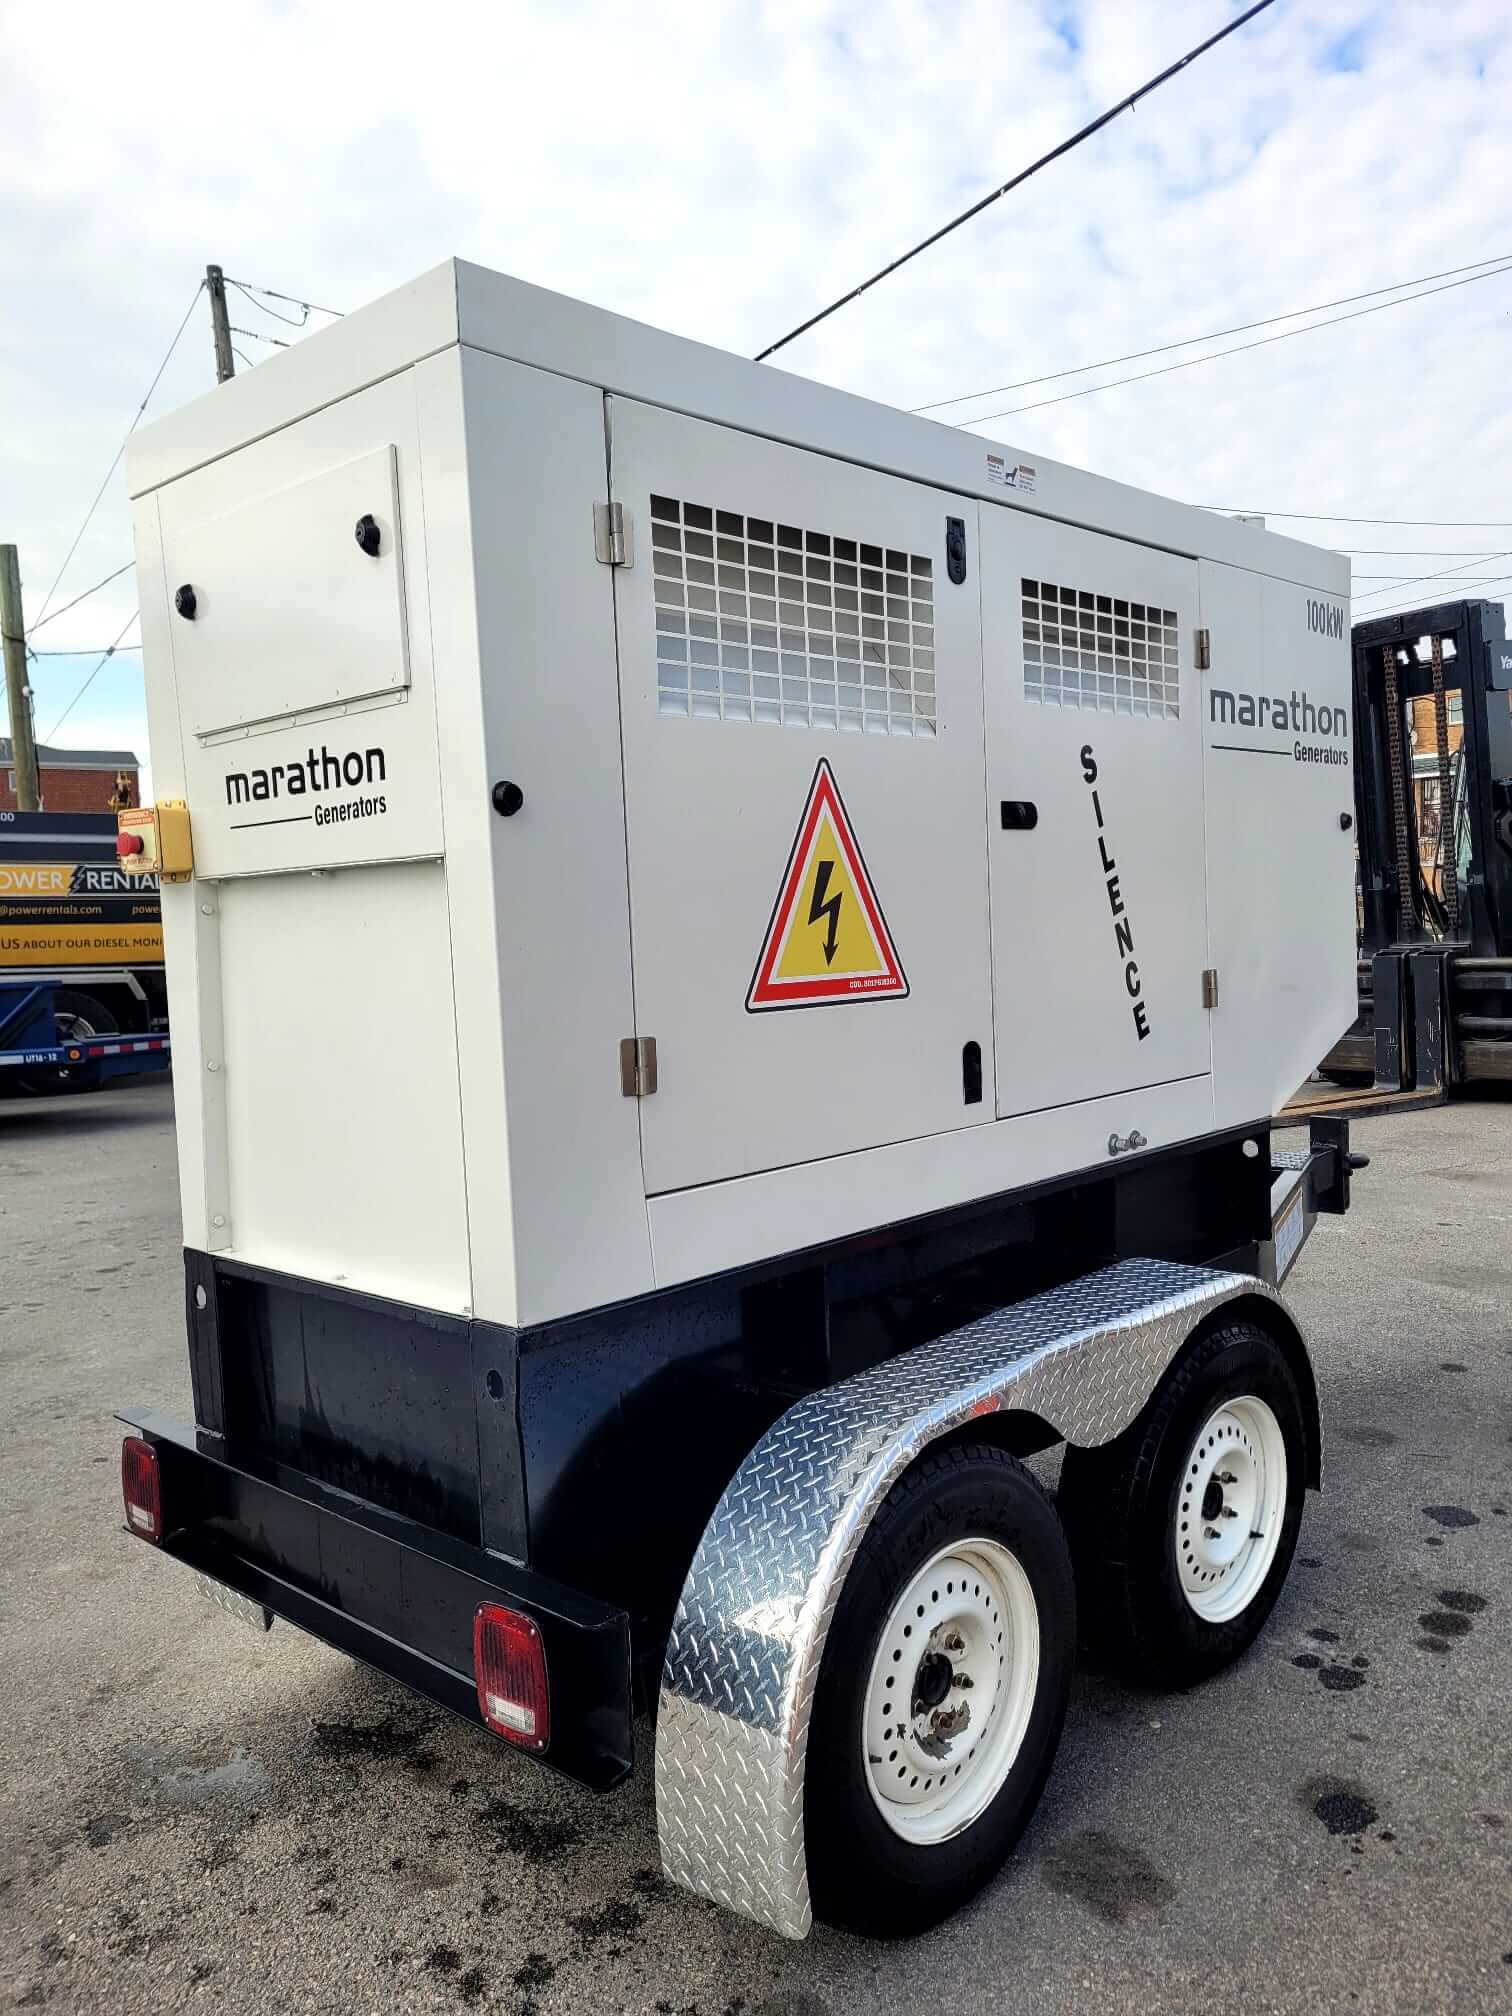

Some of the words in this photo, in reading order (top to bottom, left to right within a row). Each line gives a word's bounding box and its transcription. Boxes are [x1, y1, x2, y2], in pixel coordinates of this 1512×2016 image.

[1306, 599, 1343, 640] 100kW
[1210, 689, 1347, 737] marathon
[1294, 741, 1349, 766] Generators
[226, 746, 386, 805] marathon
[314, 795, 387, 825] Generators
[1080, 744, 1151, 1040] SILENCE
[1, 938, 20, 949] US
[23, 938, 62, 949] ABOUT
[65, 938, 91, 948] OUR
[94, 937, 129, 947] DIESEL
[133, 937, 162, 947] MON
